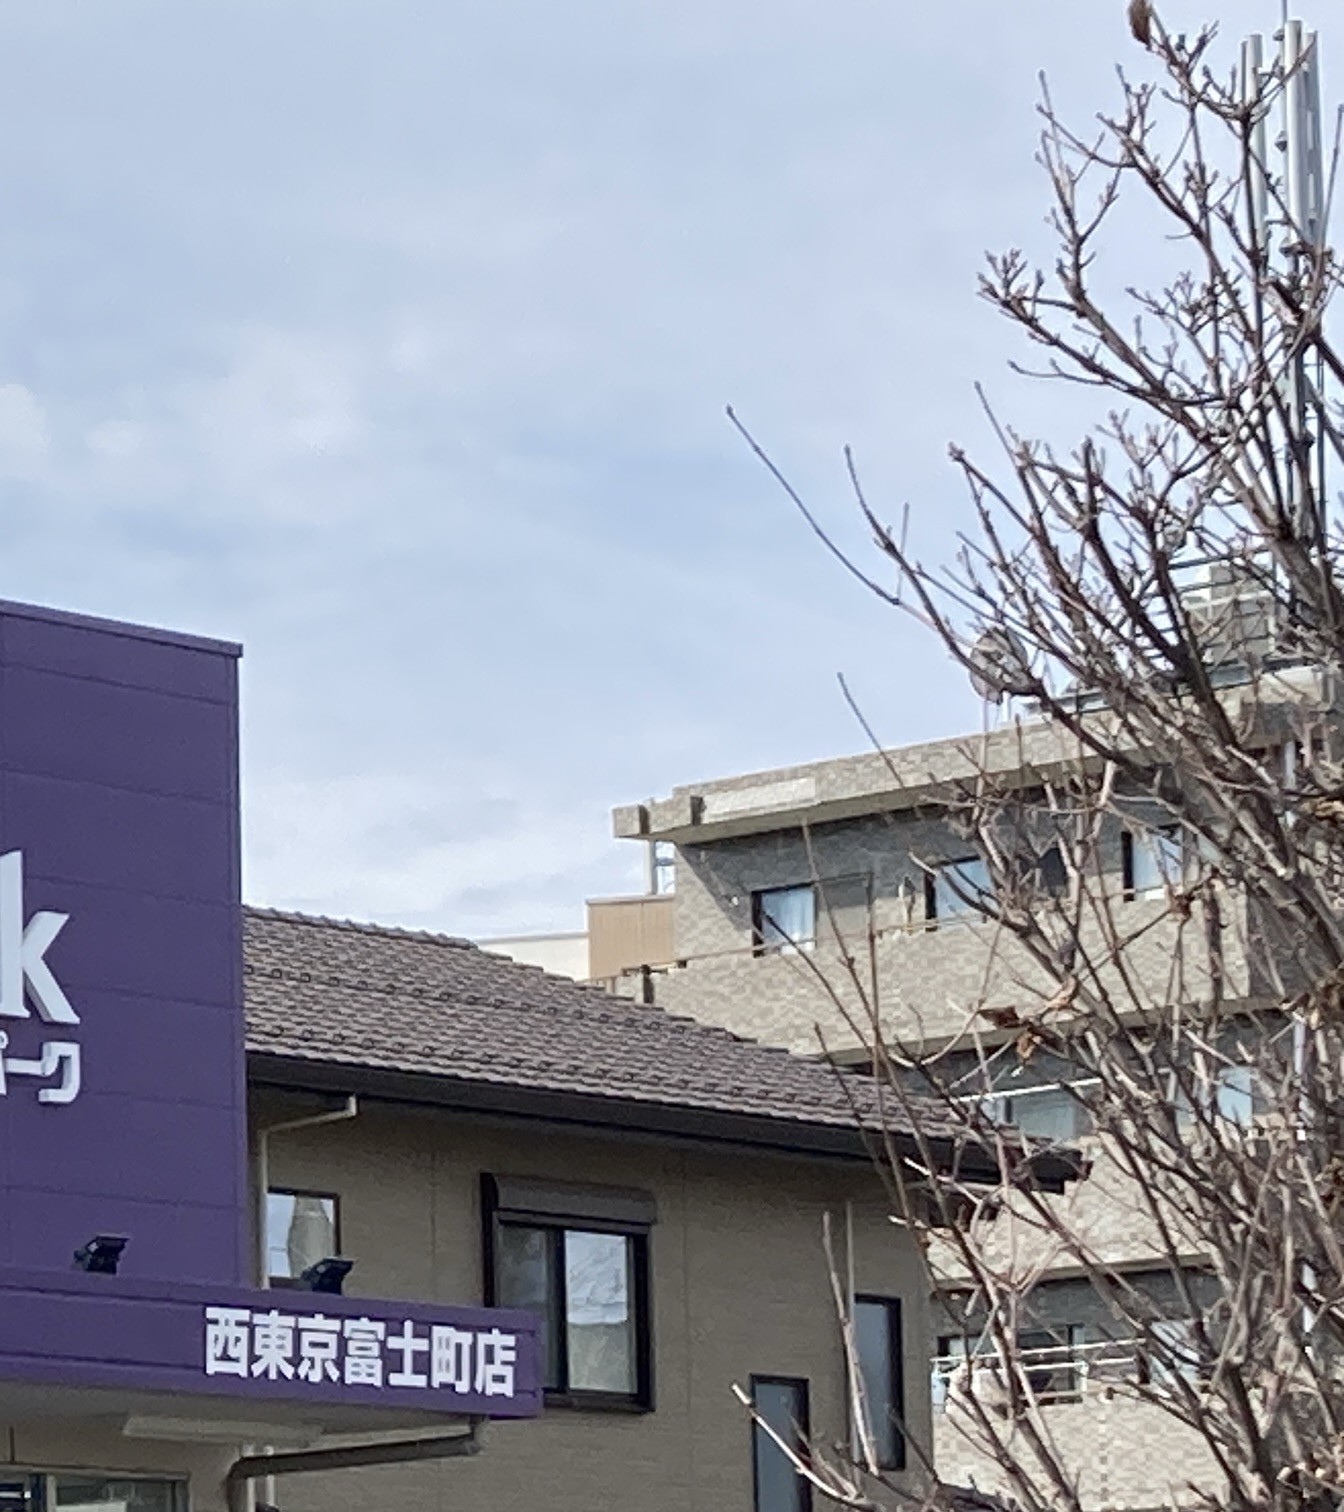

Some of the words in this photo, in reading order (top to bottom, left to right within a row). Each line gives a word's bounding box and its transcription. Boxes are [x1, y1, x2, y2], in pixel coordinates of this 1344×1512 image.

[204, 1306, 517, 1398] 西東京富士町店
